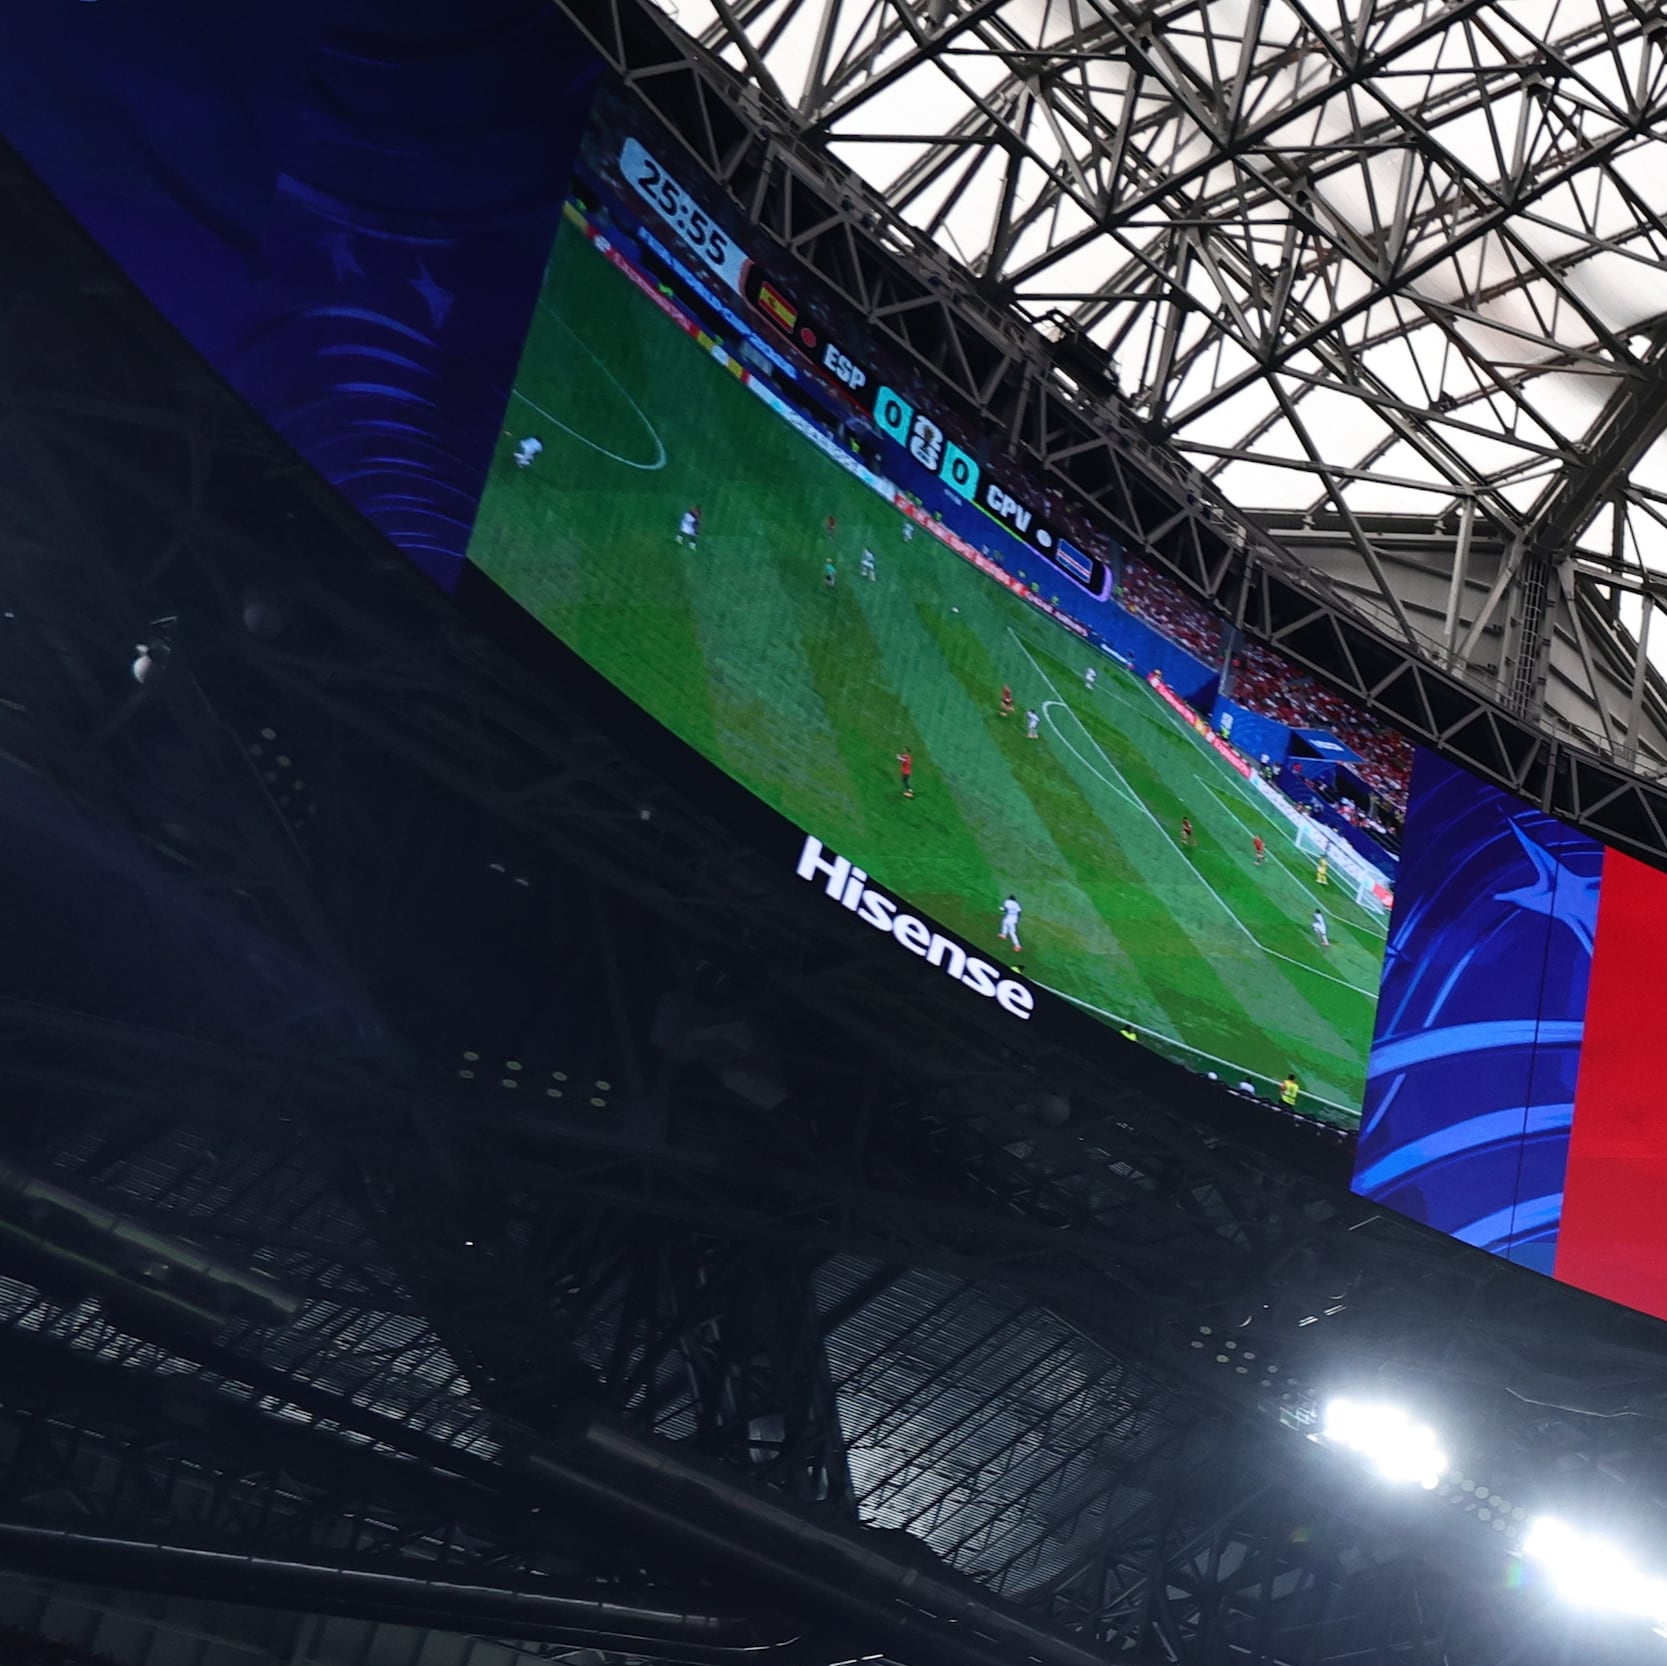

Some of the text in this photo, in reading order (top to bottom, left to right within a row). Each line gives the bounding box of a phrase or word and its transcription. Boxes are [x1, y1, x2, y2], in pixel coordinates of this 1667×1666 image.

[638, 159, 728, 266] 25:55
[822, 343, 866, 390] ESP
[986, 484, 1032, 533] CPV
[796, 834, 1034, 1020] Hisense
